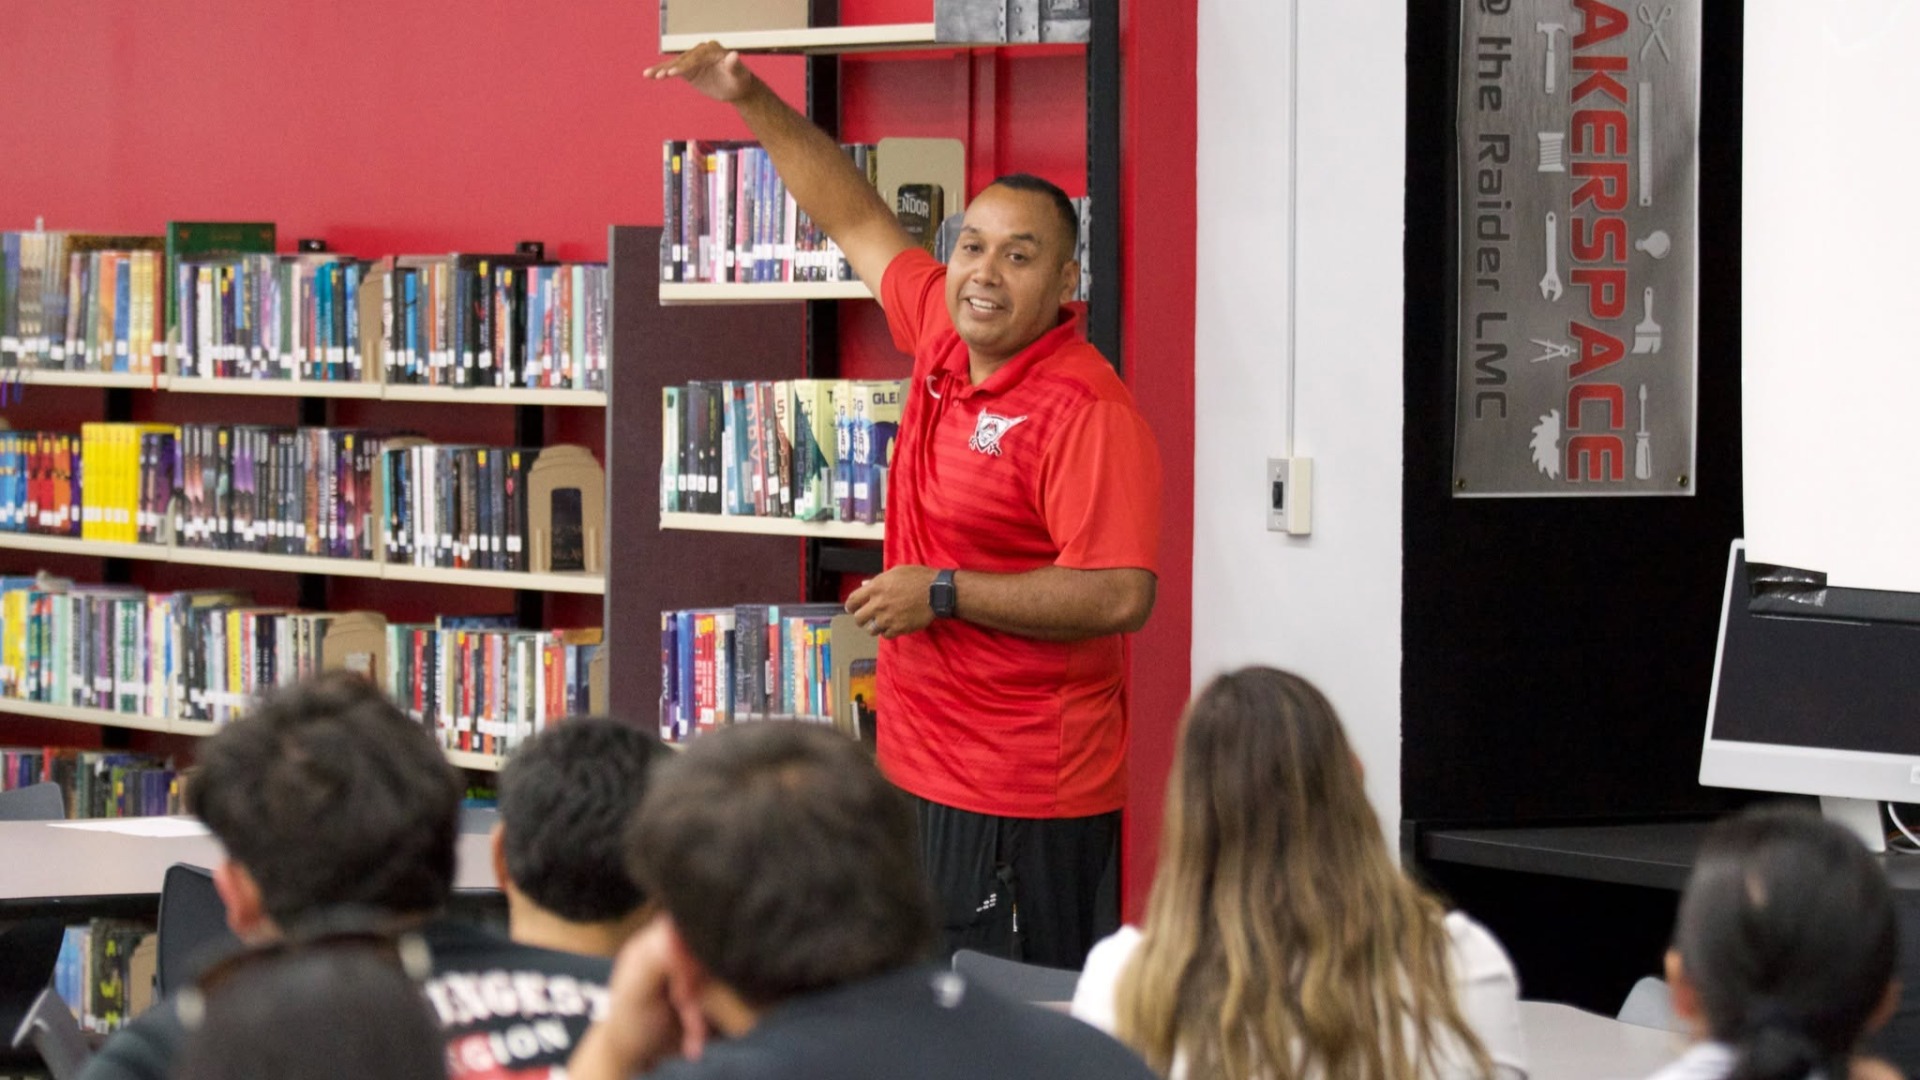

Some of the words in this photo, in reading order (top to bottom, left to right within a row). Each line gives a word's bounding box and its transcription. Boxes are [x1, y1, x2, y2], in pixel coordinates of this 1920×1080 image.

[1476, 133, 1511, 293] Raider
[872, 391, 900, 406] GLE
[1474, 311, 1508, 420] LMC
